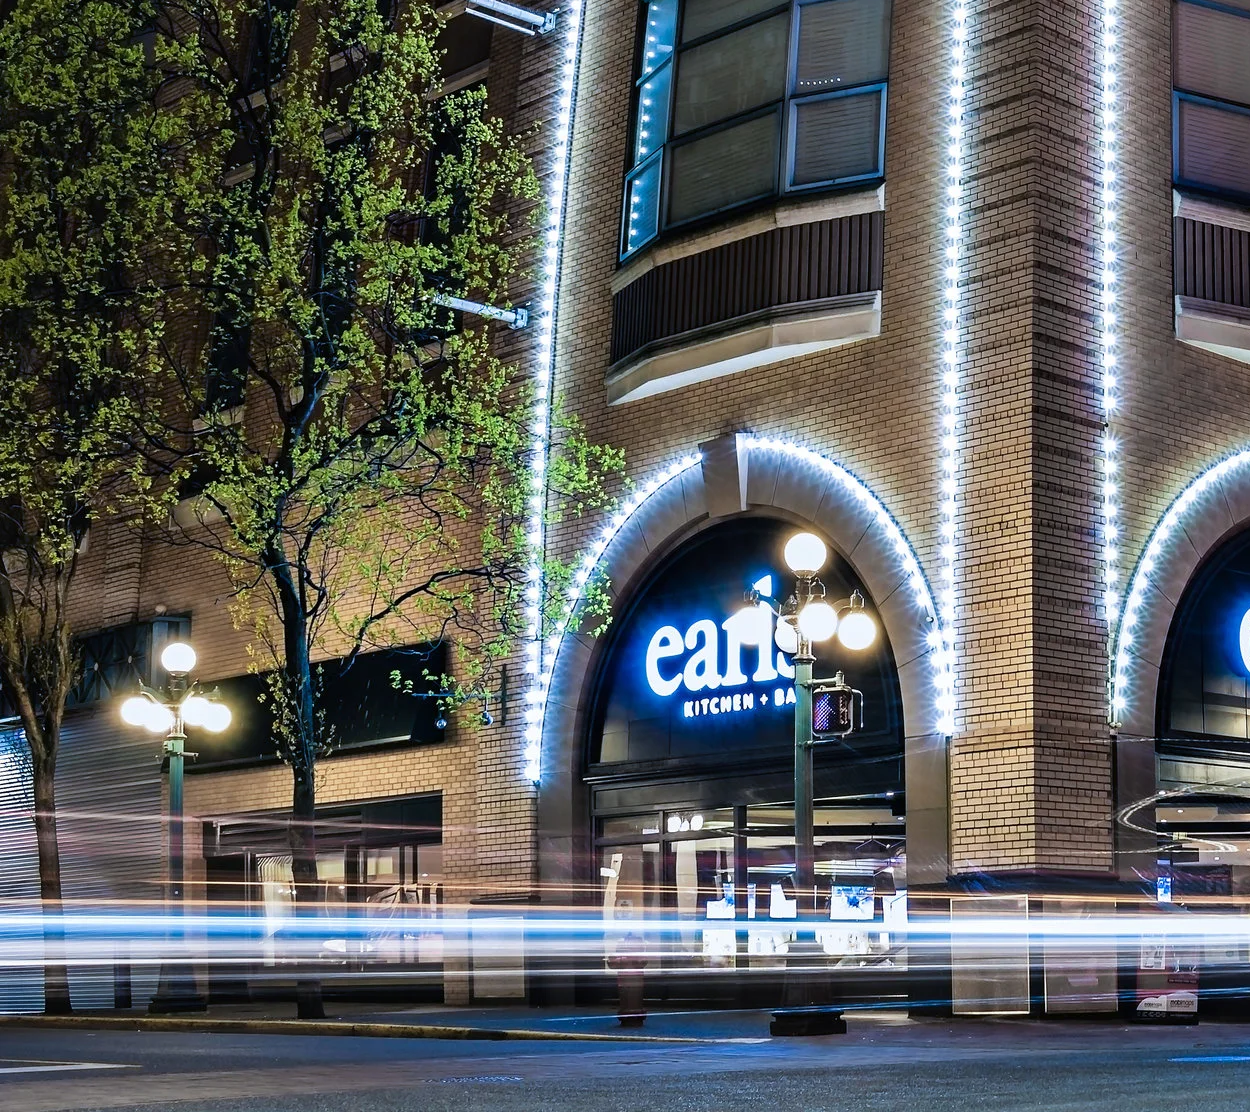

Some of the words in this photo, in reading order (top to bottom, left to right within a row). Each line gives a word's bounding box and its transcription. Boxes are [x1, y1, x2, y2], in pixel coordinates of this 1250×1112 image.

[645, 575, 796, 696] earl
[684, 693, 754, 718] KITCHEN
[774, 687, 797, 708] BA
